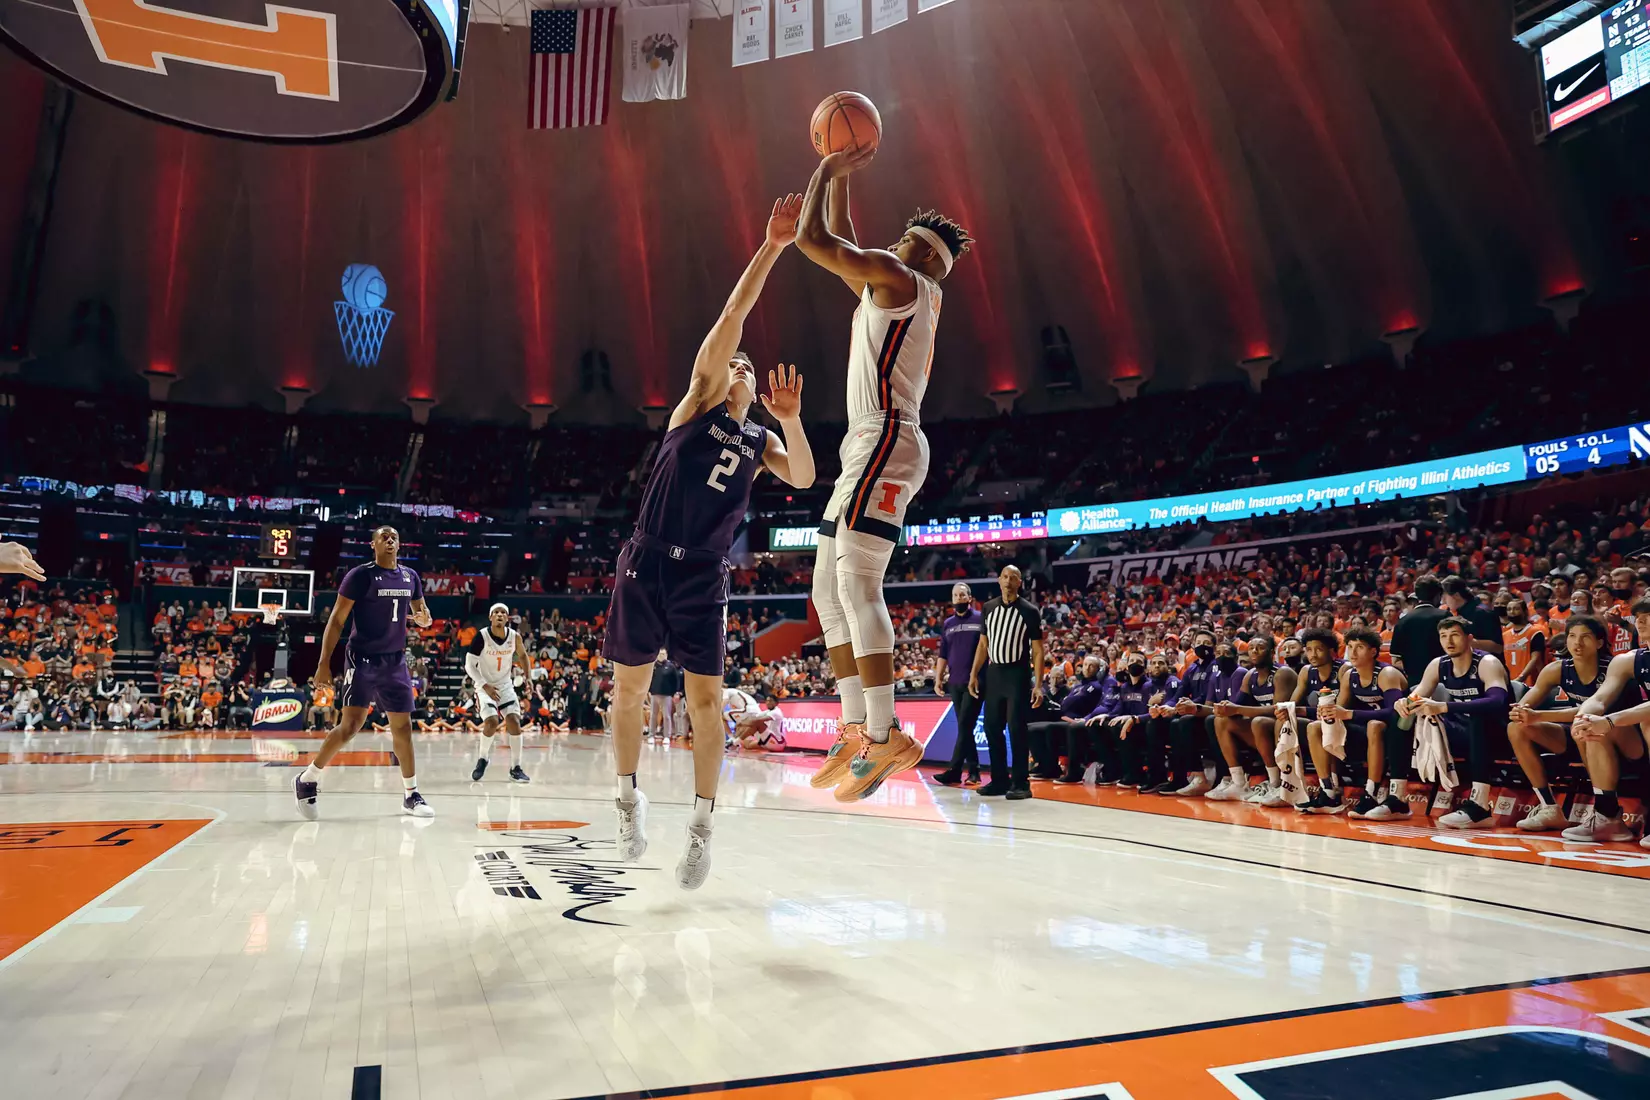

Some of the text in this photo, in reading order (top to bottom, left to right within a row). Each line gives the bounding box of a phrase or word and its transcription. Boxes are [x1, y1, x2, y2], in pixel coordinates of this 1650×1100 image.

[792, 4, 797, 13] 1
[749, 16, 754, 26] 1
[1624, 13, 1641, 28] 13
[785, 24, 803, 33] CHUCK
[1608, 22, 1619, 39] N
[1529, 433, 1614, 457] FOULS T.O.L.
[1535, 447, 1601, 474] 05 4
[706, 448, 740, 493] 2
[1149, 461, 1511, 519] The Official Health Insurance Partner of Fighting Illini Athletics
[1081, 507, 1119, 520] Health
[271, 529, 291, 539] 9:27
[910, 525, 920, 537] N
[946, 525, 961, 533] 35.7
[968, 523, 979, 531] 2-6
[273, 540, 288, 555] 15
[672, 548, 682, 558] N
[1086, 549, 1258, 588] FIGHTING
[392, 598, 399, 622] 1
[1615, 627, 1630, 642] 21
[497, 656, 503, 672] 1
[1510, 652, 1517, 665] 1
[343, 667, 356, 686] N
[253, 703, 298, 723] LIBMAN
[782, 717, 812, 733] PONSOR
[813, 719, 826, 733] OF
